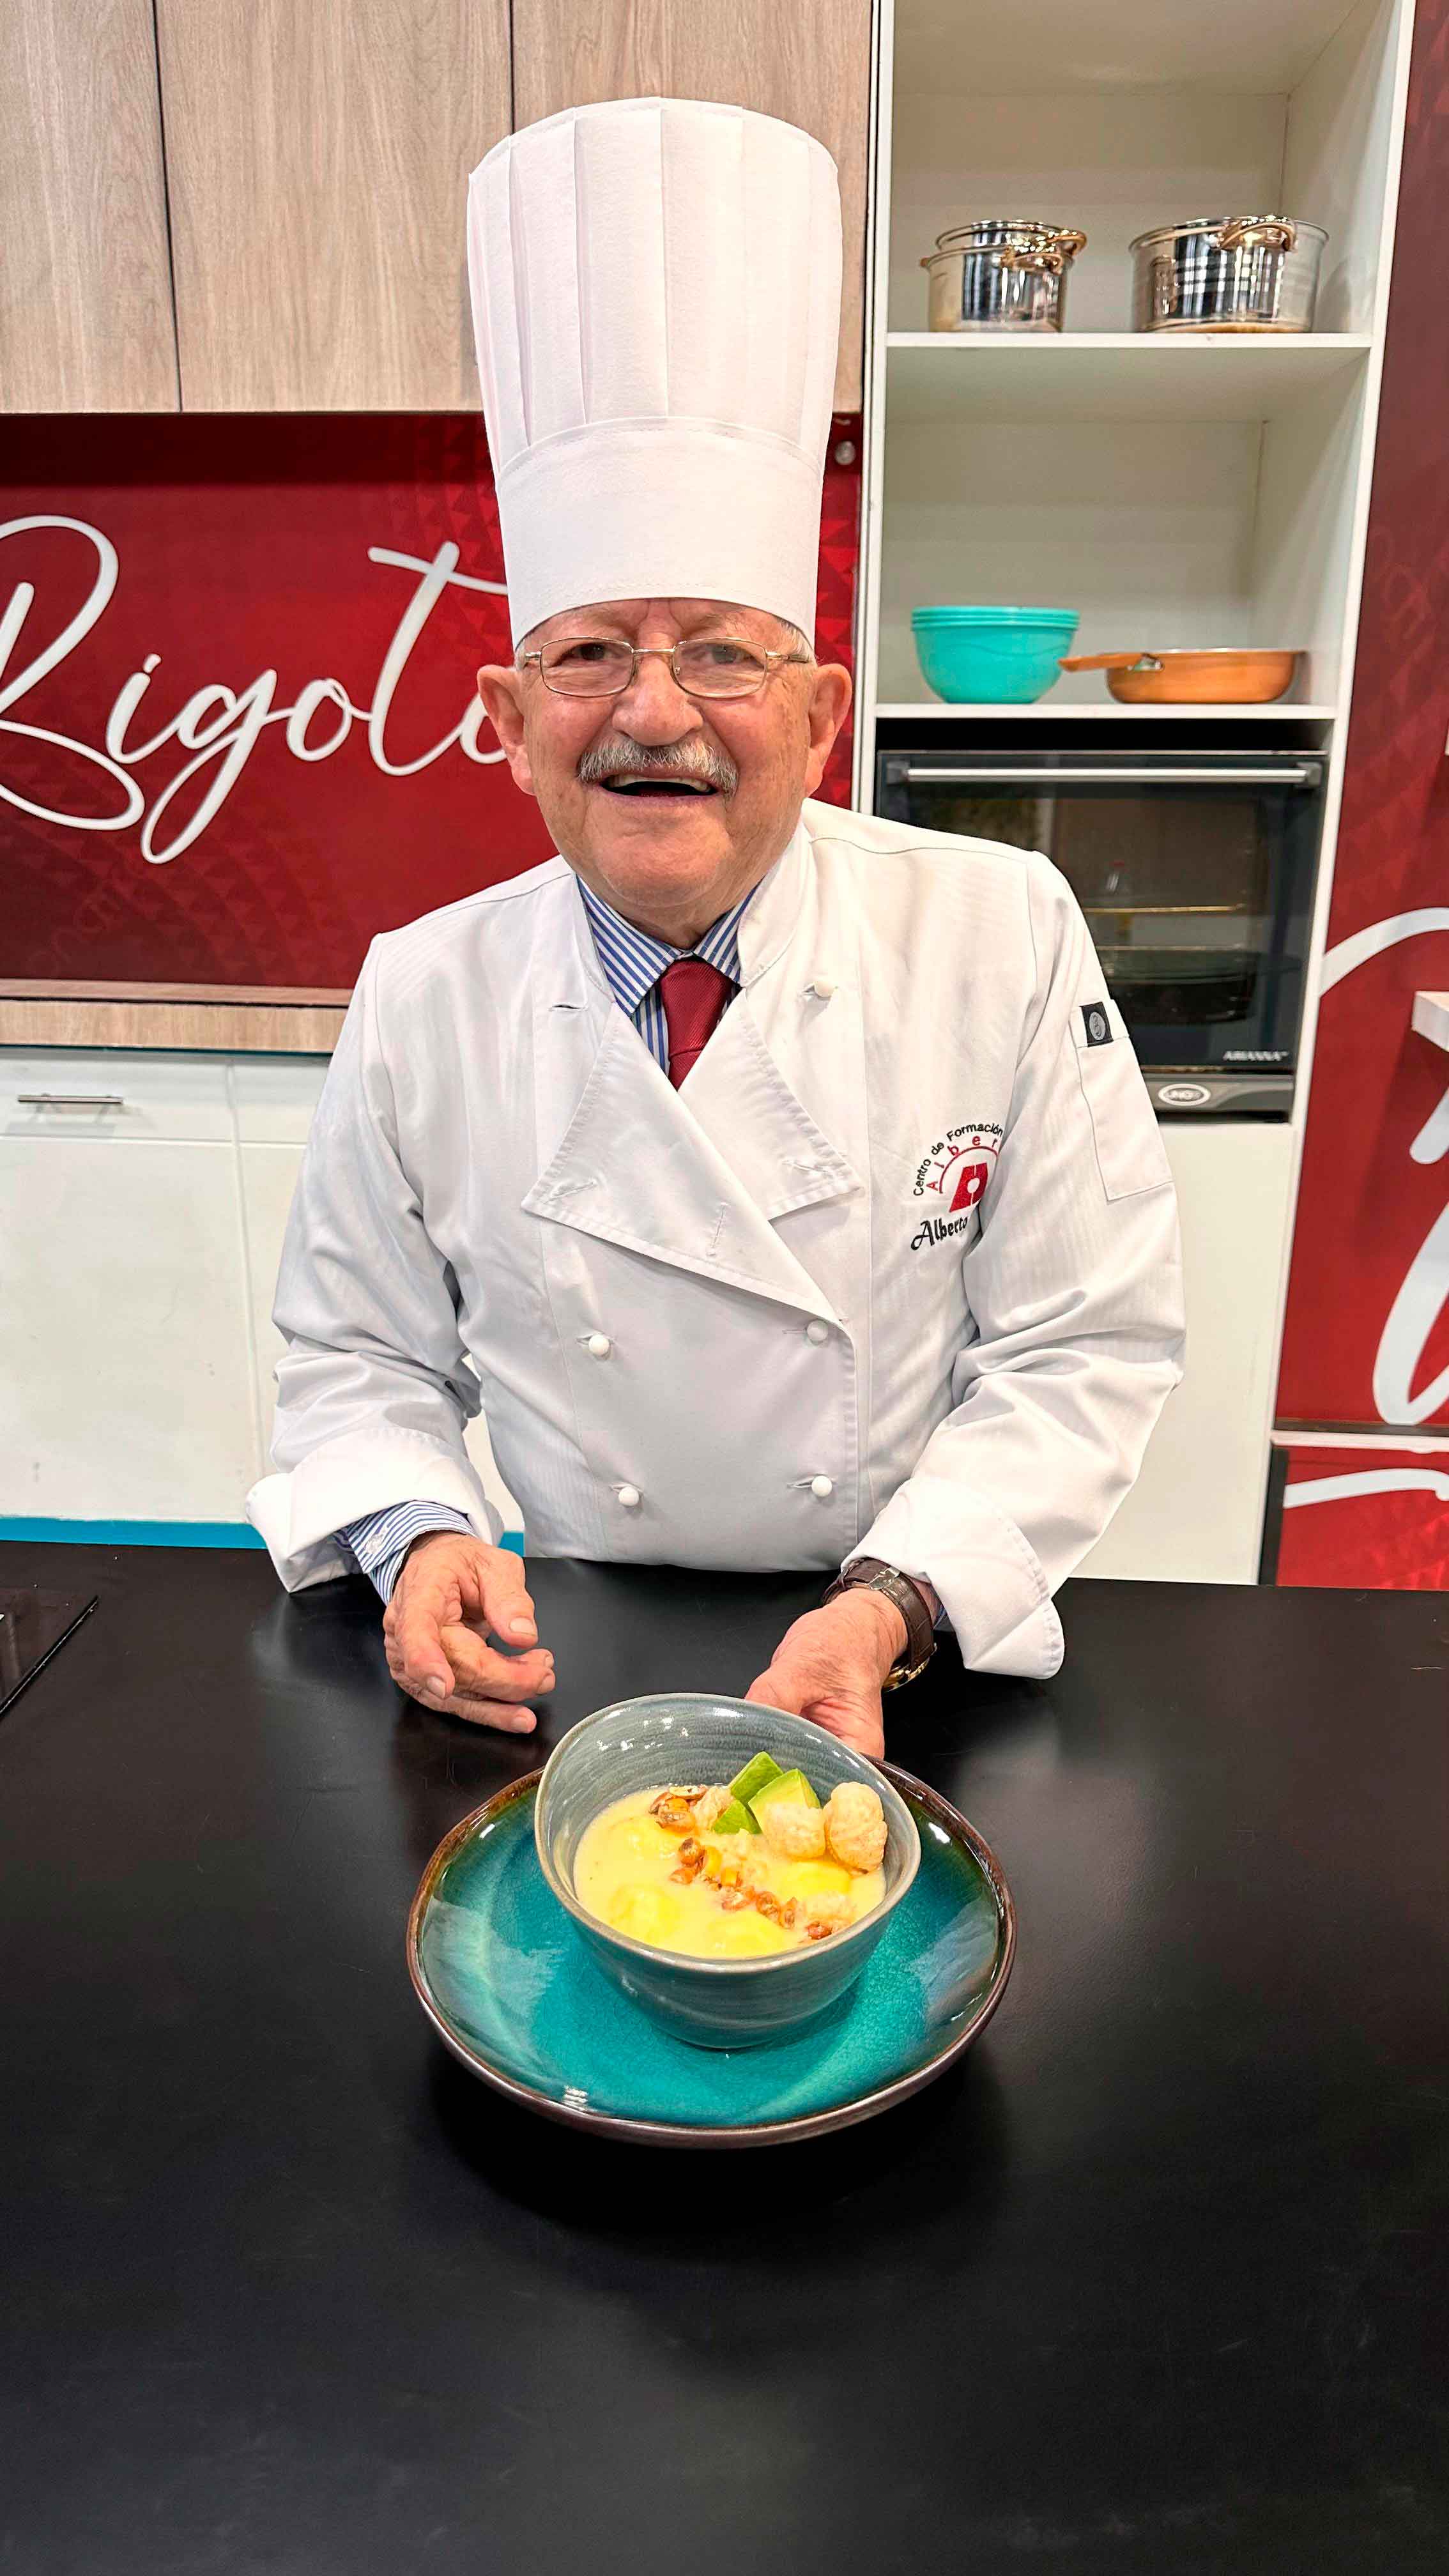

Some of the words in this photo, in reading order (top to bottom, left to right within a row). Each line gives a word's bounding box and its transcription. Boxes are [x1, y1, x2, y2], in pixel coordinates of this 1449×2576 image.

[913, 1158, 931, 1196] Centro
[931, 1142, 945, 1156] de
[946, 1123, 1004, 1142] Formación
[910, 1216, 969, 1251] Alberto
